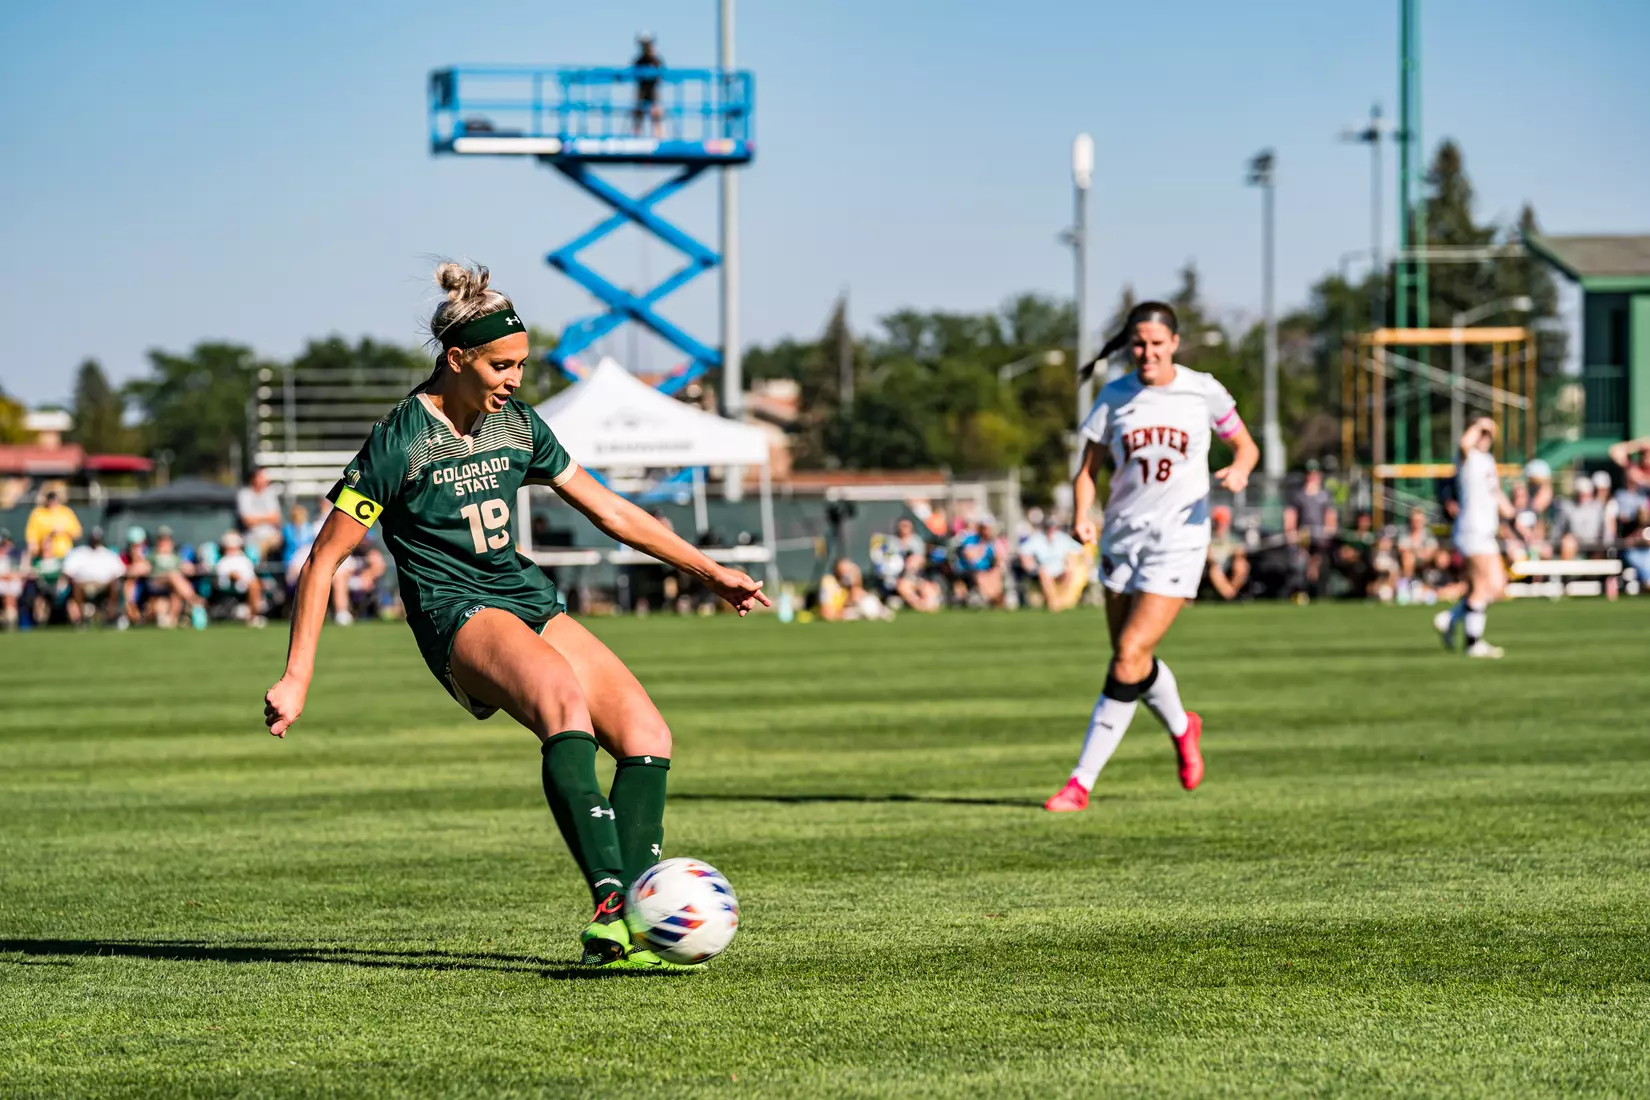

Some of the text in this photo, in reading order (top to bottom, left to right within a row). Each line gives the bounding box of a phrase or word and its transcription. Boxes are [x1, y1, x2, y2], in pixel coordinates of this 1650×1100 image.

[433, 457, 510, 485] COLORADO
[1138, 457, 1172, 483] 18
[455, 474, 499, 496] STATE
[355, 500, 374, 520] C
[460, 498, 510, 554] 19
